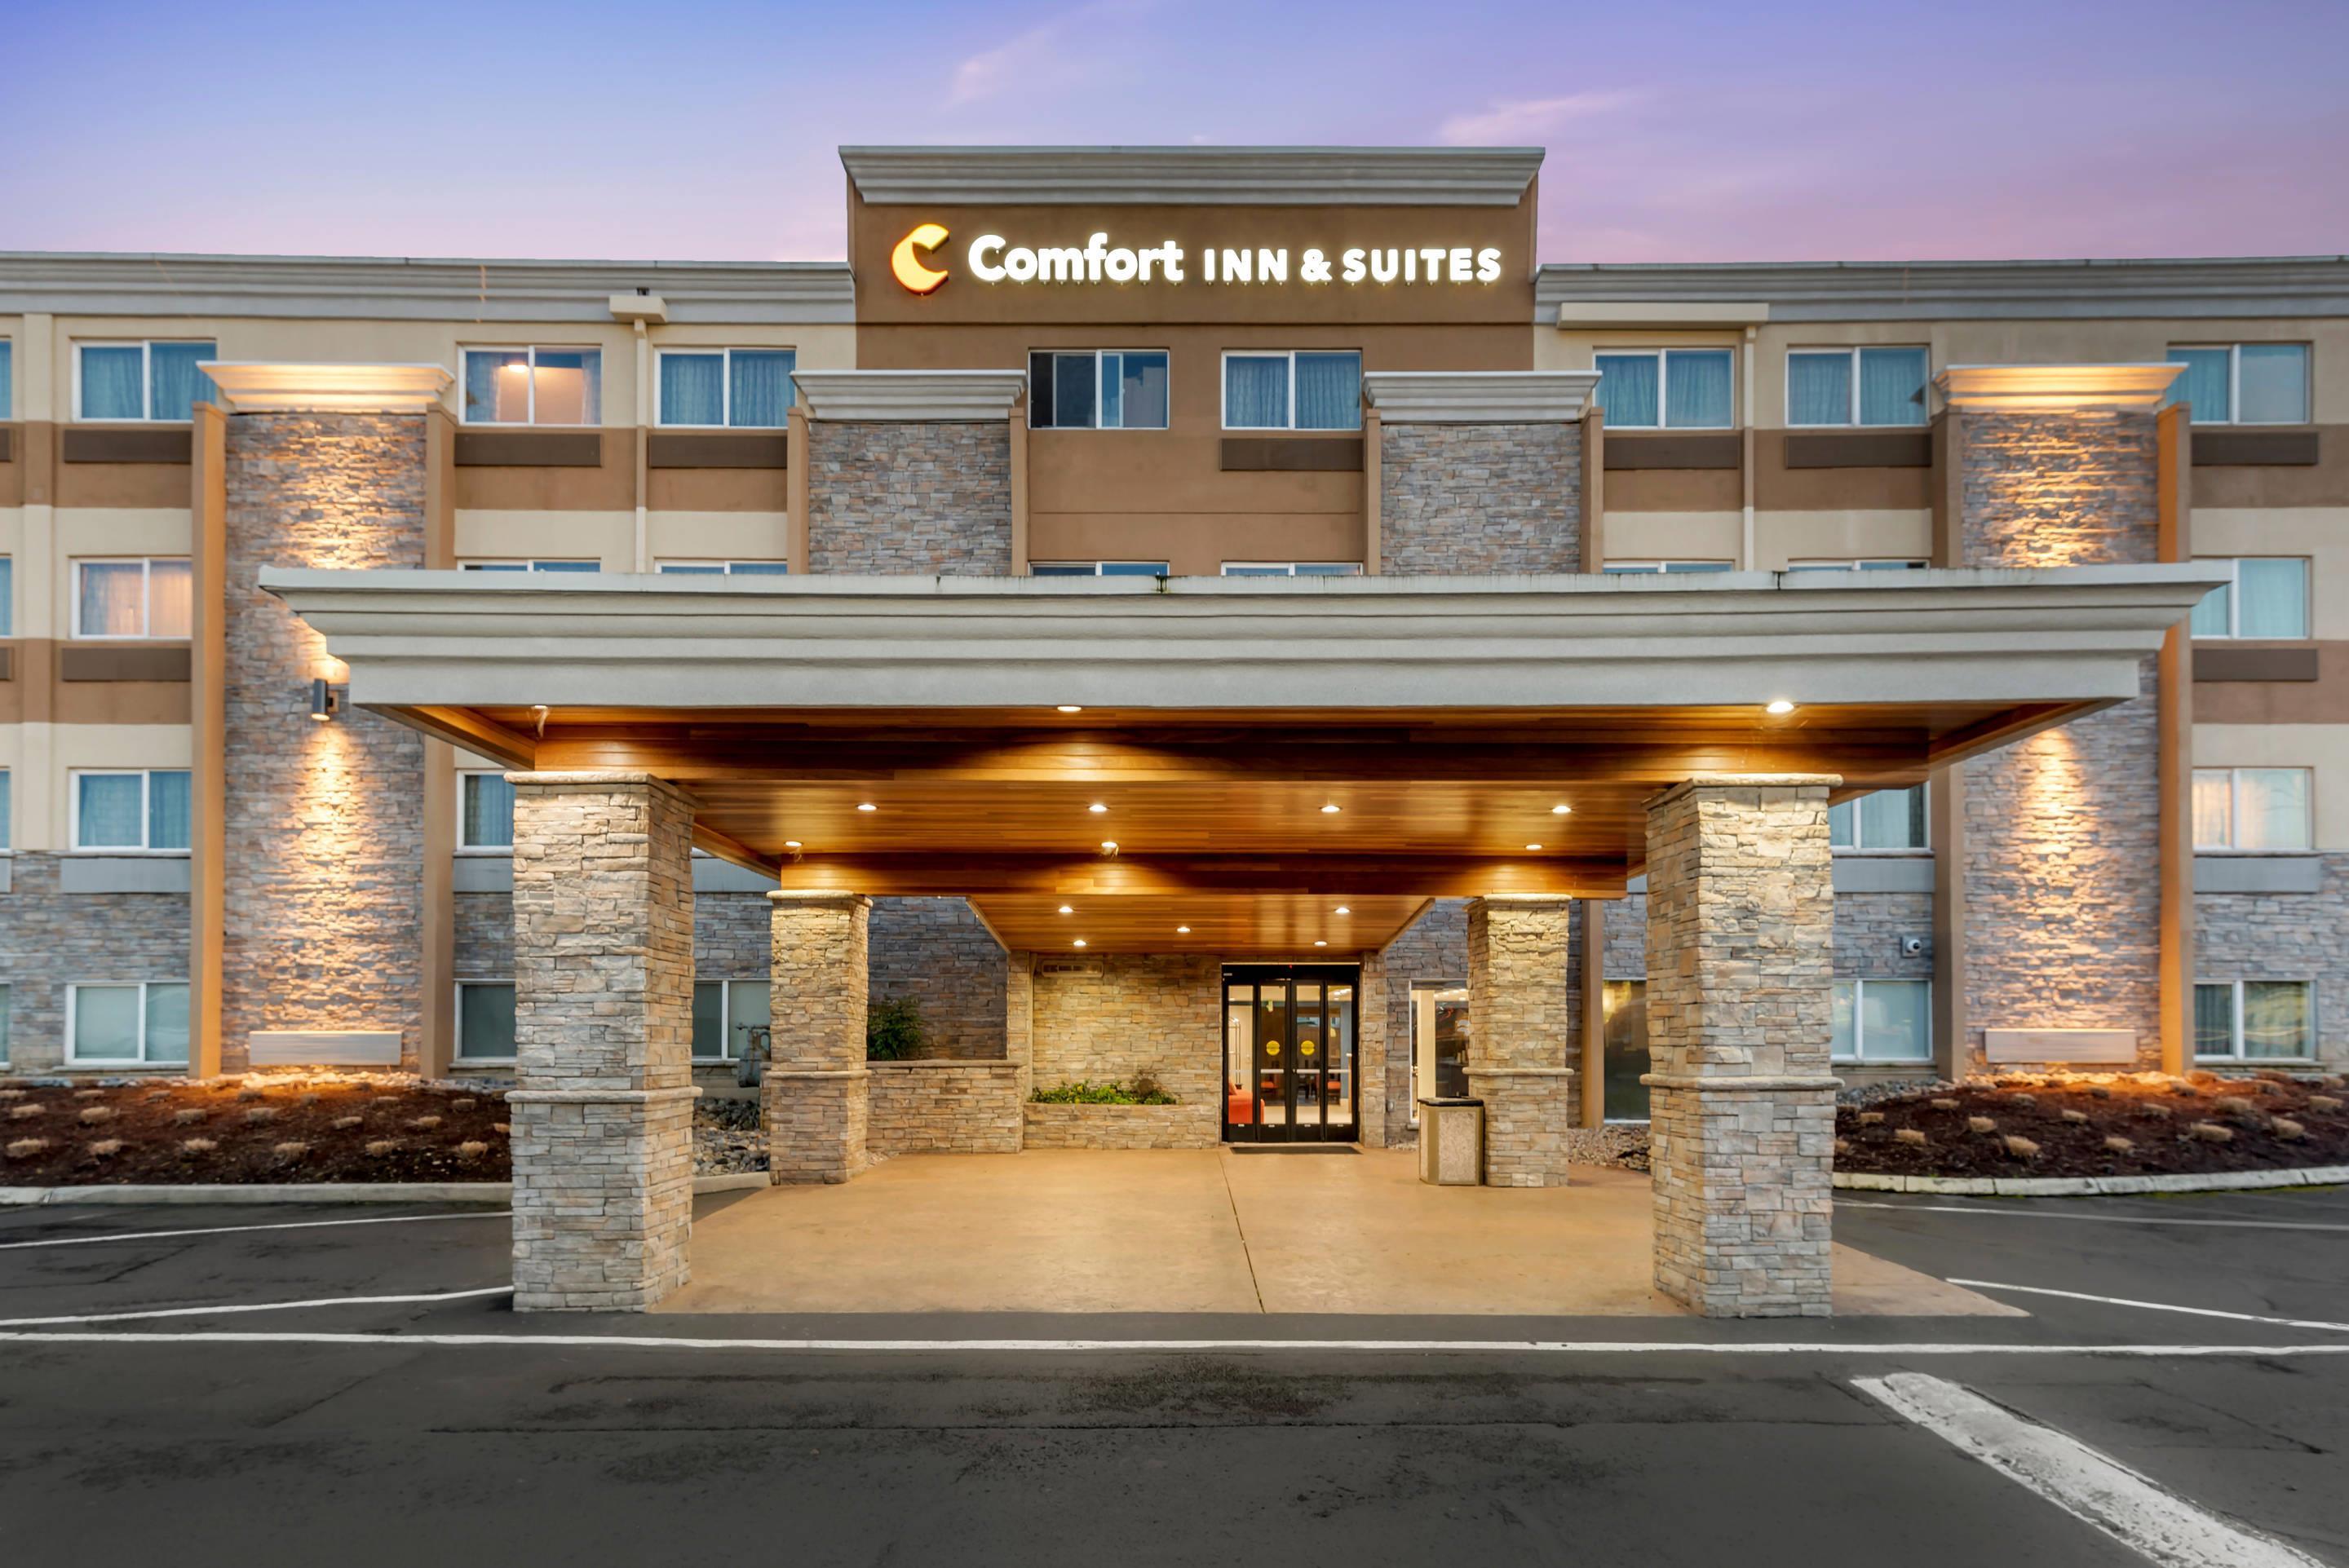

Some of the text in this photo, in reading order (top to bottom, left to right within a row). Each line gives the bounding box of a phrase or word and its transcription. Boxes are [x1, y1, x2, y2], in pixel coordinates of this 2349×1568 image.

[968, 232, 1502, 283] Comfort INN & SUITES
